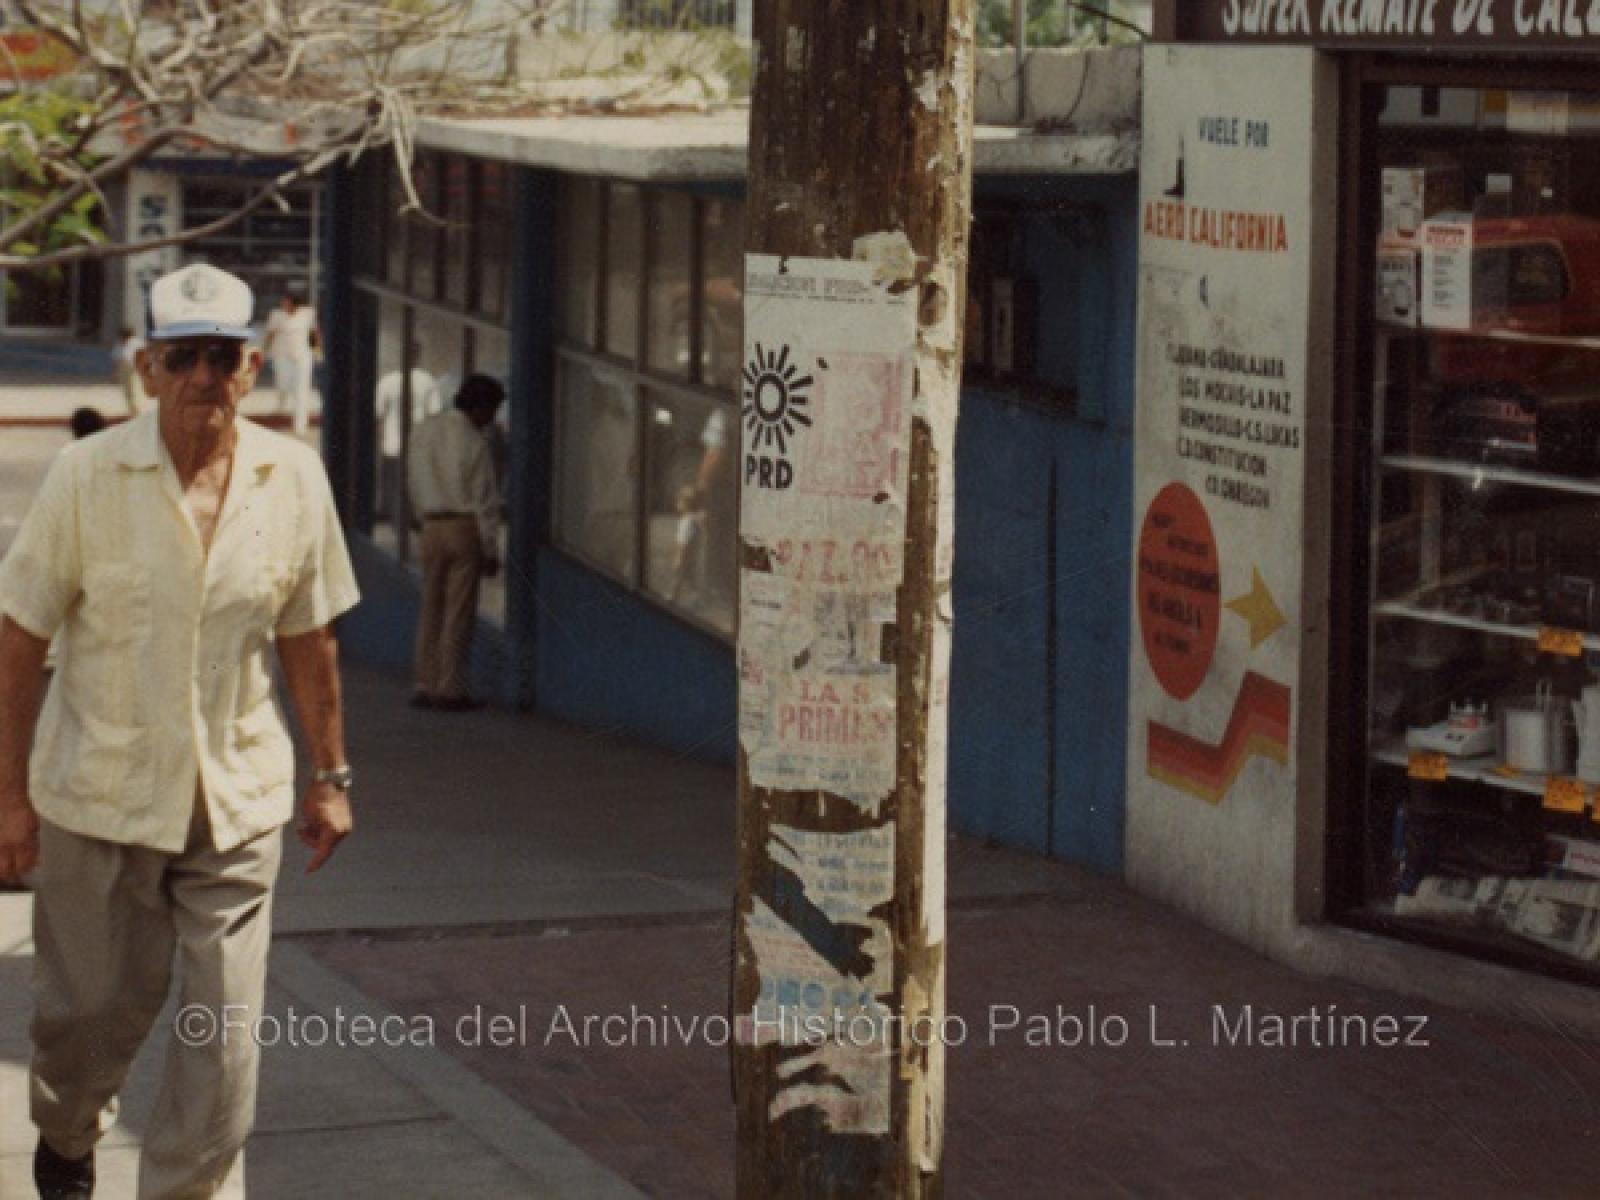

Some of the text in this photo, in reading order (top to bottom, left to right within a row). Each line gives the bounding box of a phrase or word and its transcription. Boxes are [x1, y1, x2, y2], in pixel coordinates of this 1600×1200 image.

[1199, 117, 1240, 145] VUELE
[1144, 202, 1288, 251] AERO CALIFORNIA
[1268, 389, 1291, 415] PAZ
[744, 453, 793, 489] PRD
